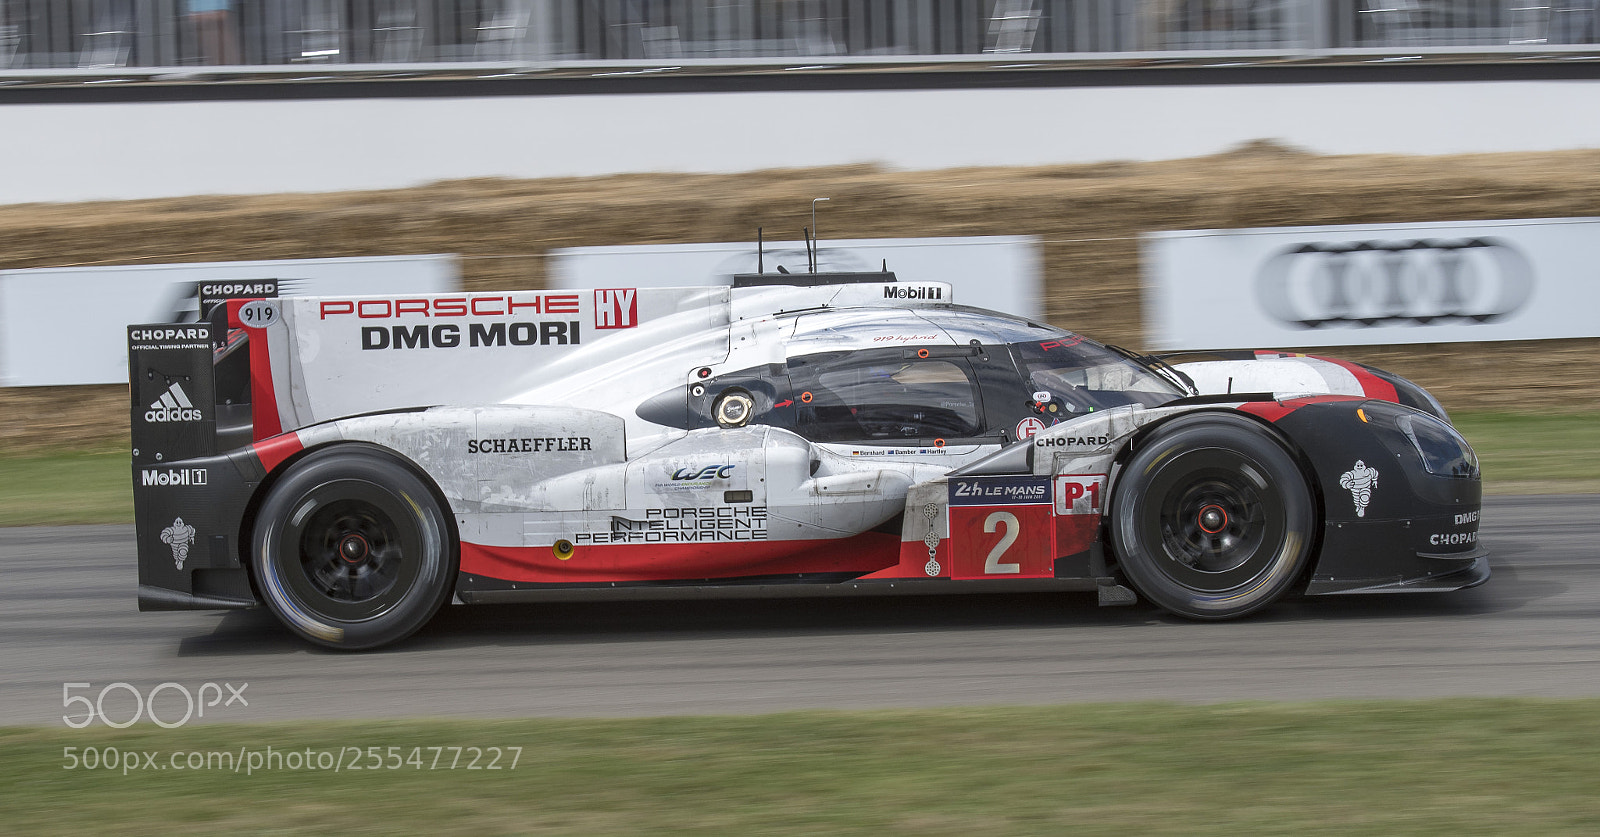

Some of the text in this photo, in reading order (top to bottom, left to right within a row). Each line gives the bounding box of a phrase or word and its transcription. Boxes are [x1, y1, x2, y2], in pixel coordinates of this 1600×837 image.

[202, 284, 275, 295] CHOPARD
[883, 286, 942, 300] Mobil 1
[245, 307, 273, 321] 919
[320, 295, 579, 320] PORSCHE
[596, 289, 636, 328] HY
[131, 328, 209, 340] CHOPARD
[361, 321, 580, 350] DMG MORI
[145, 405, 202, 423] adidas
[468, 437, 592, 453] SCHAEFFLER
[1036, 435, 1108, 447] CHOPARD
[142, 469, 207, 486] Mobil 1
[671, 464, 735, 480] WEC
[985, 486, 1003, 496] LE
[1004, 485, 1046, 496] MANS
[1065, 482, 1099, 510] P1
[646, 507, 767, 519] PORSCHE
[610, 518, 767, 532] INTELLIGENT
[575, 530, 767, 544] PERFORMANCE
[983, 511, 1020, 574] 2
